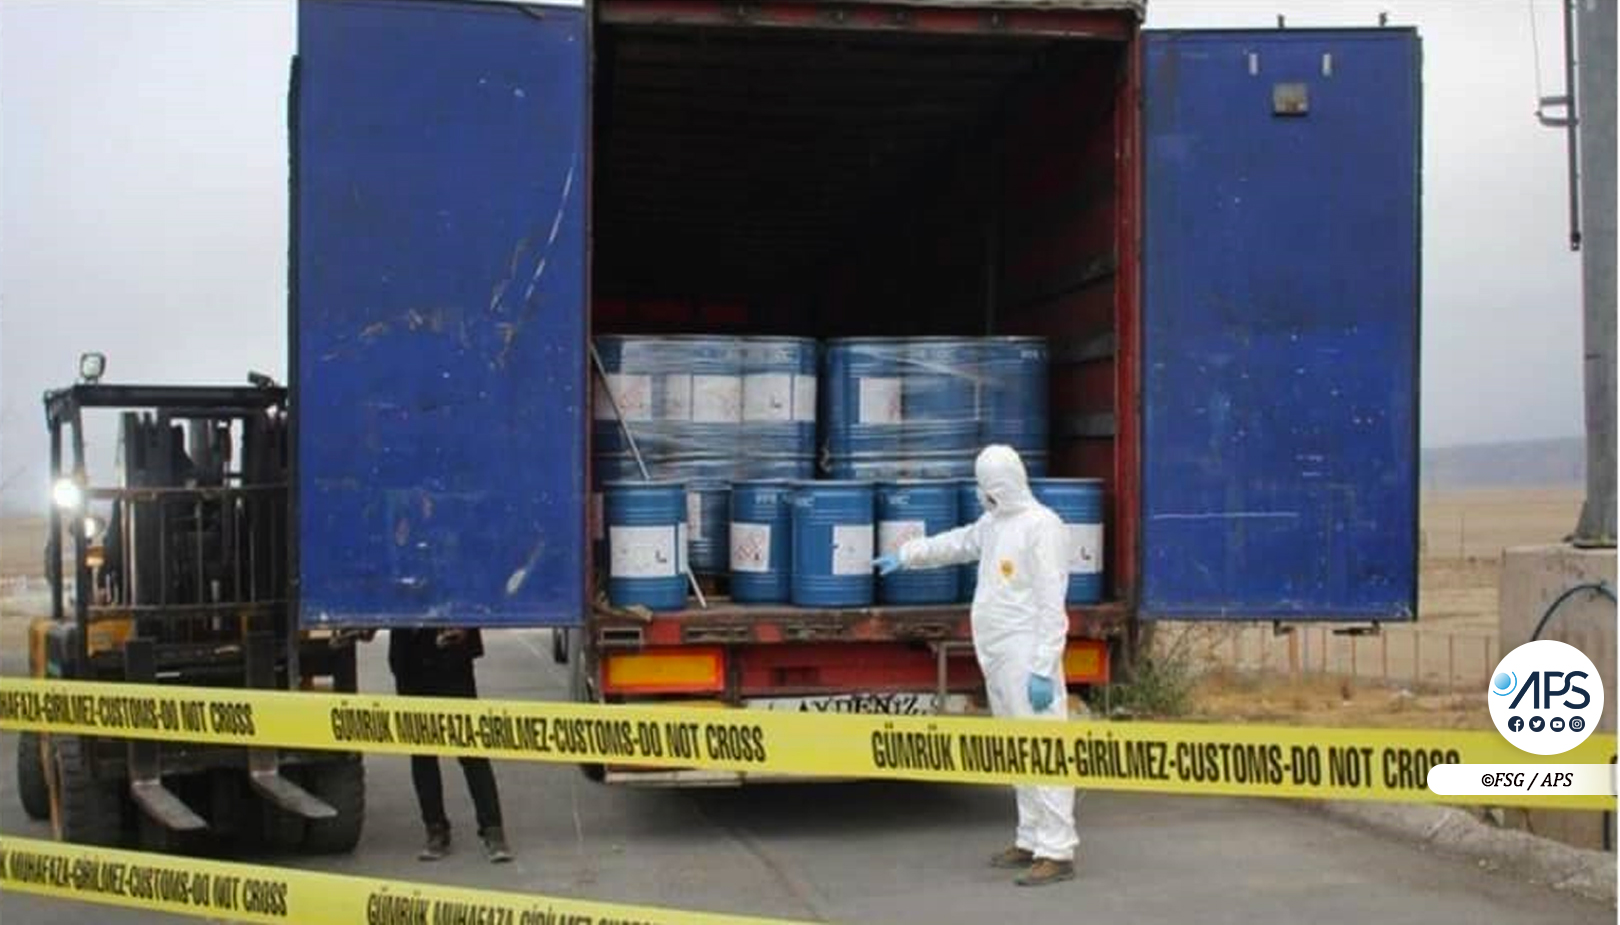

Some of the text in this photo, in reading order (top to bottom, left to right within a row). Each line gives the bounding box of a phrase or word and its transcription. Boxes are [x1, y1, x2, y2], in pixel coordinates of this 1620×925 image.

[181, 700, 206, 733] NOT
[209, 702, 255, 735] CROSS
[331, 701, 394, 743] GÜMRÜK
[666, 722, 702, 759] NOT
[706, 724, 765, 762] CROSS
[871, 722, 956, 771] GÜMRÜK
[1328, 747, 1374, 788] NOT
[213, 875, 240, 911] NOT
[243, 878, 287, 916] CROSS
